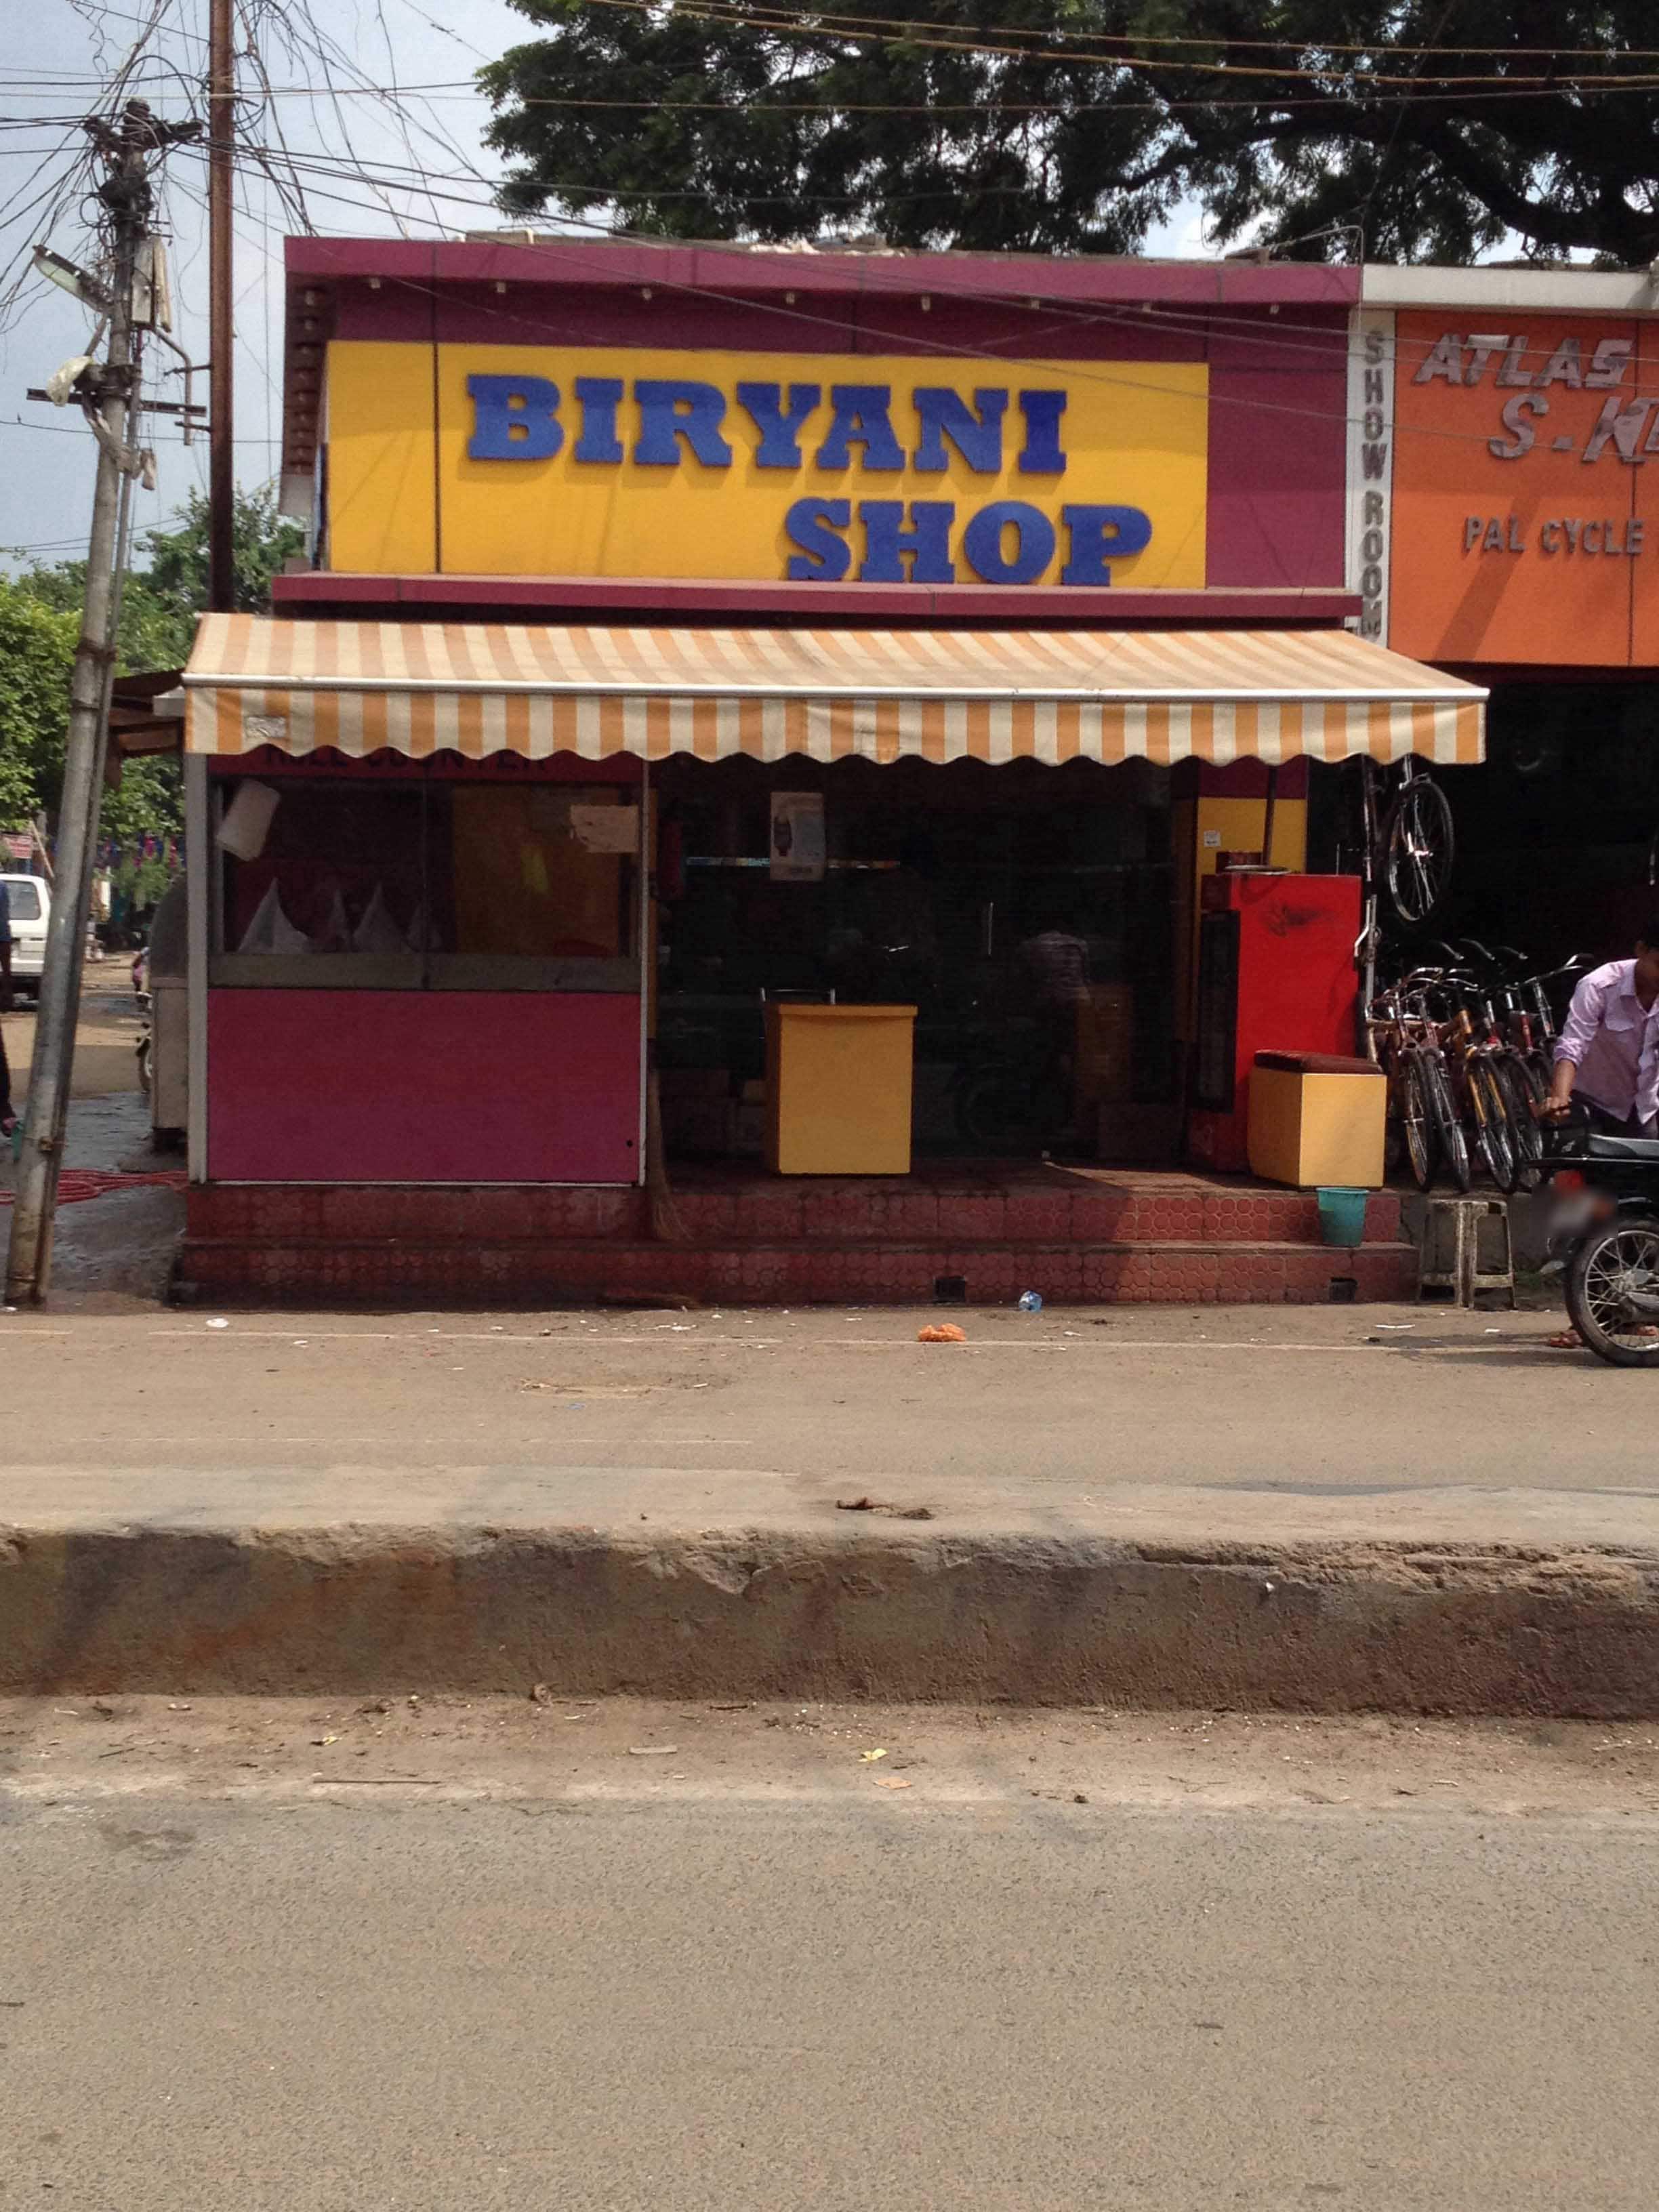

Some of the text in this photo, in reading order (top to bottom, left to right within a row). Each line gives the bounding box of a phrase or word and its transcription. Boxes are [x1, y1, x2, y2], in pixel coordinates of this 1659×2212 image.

[1413, 333, 1635, 389] ATLAS
[467, 374, 1067, 473] BIRYANI
[1361, 329, 1387, 636] SHOW ROOM
[783, 497, 1153, 587] SHOP
[1462, 516, 1526, 554] PAL
[1540, 517, 1645, 555] CYCLE
